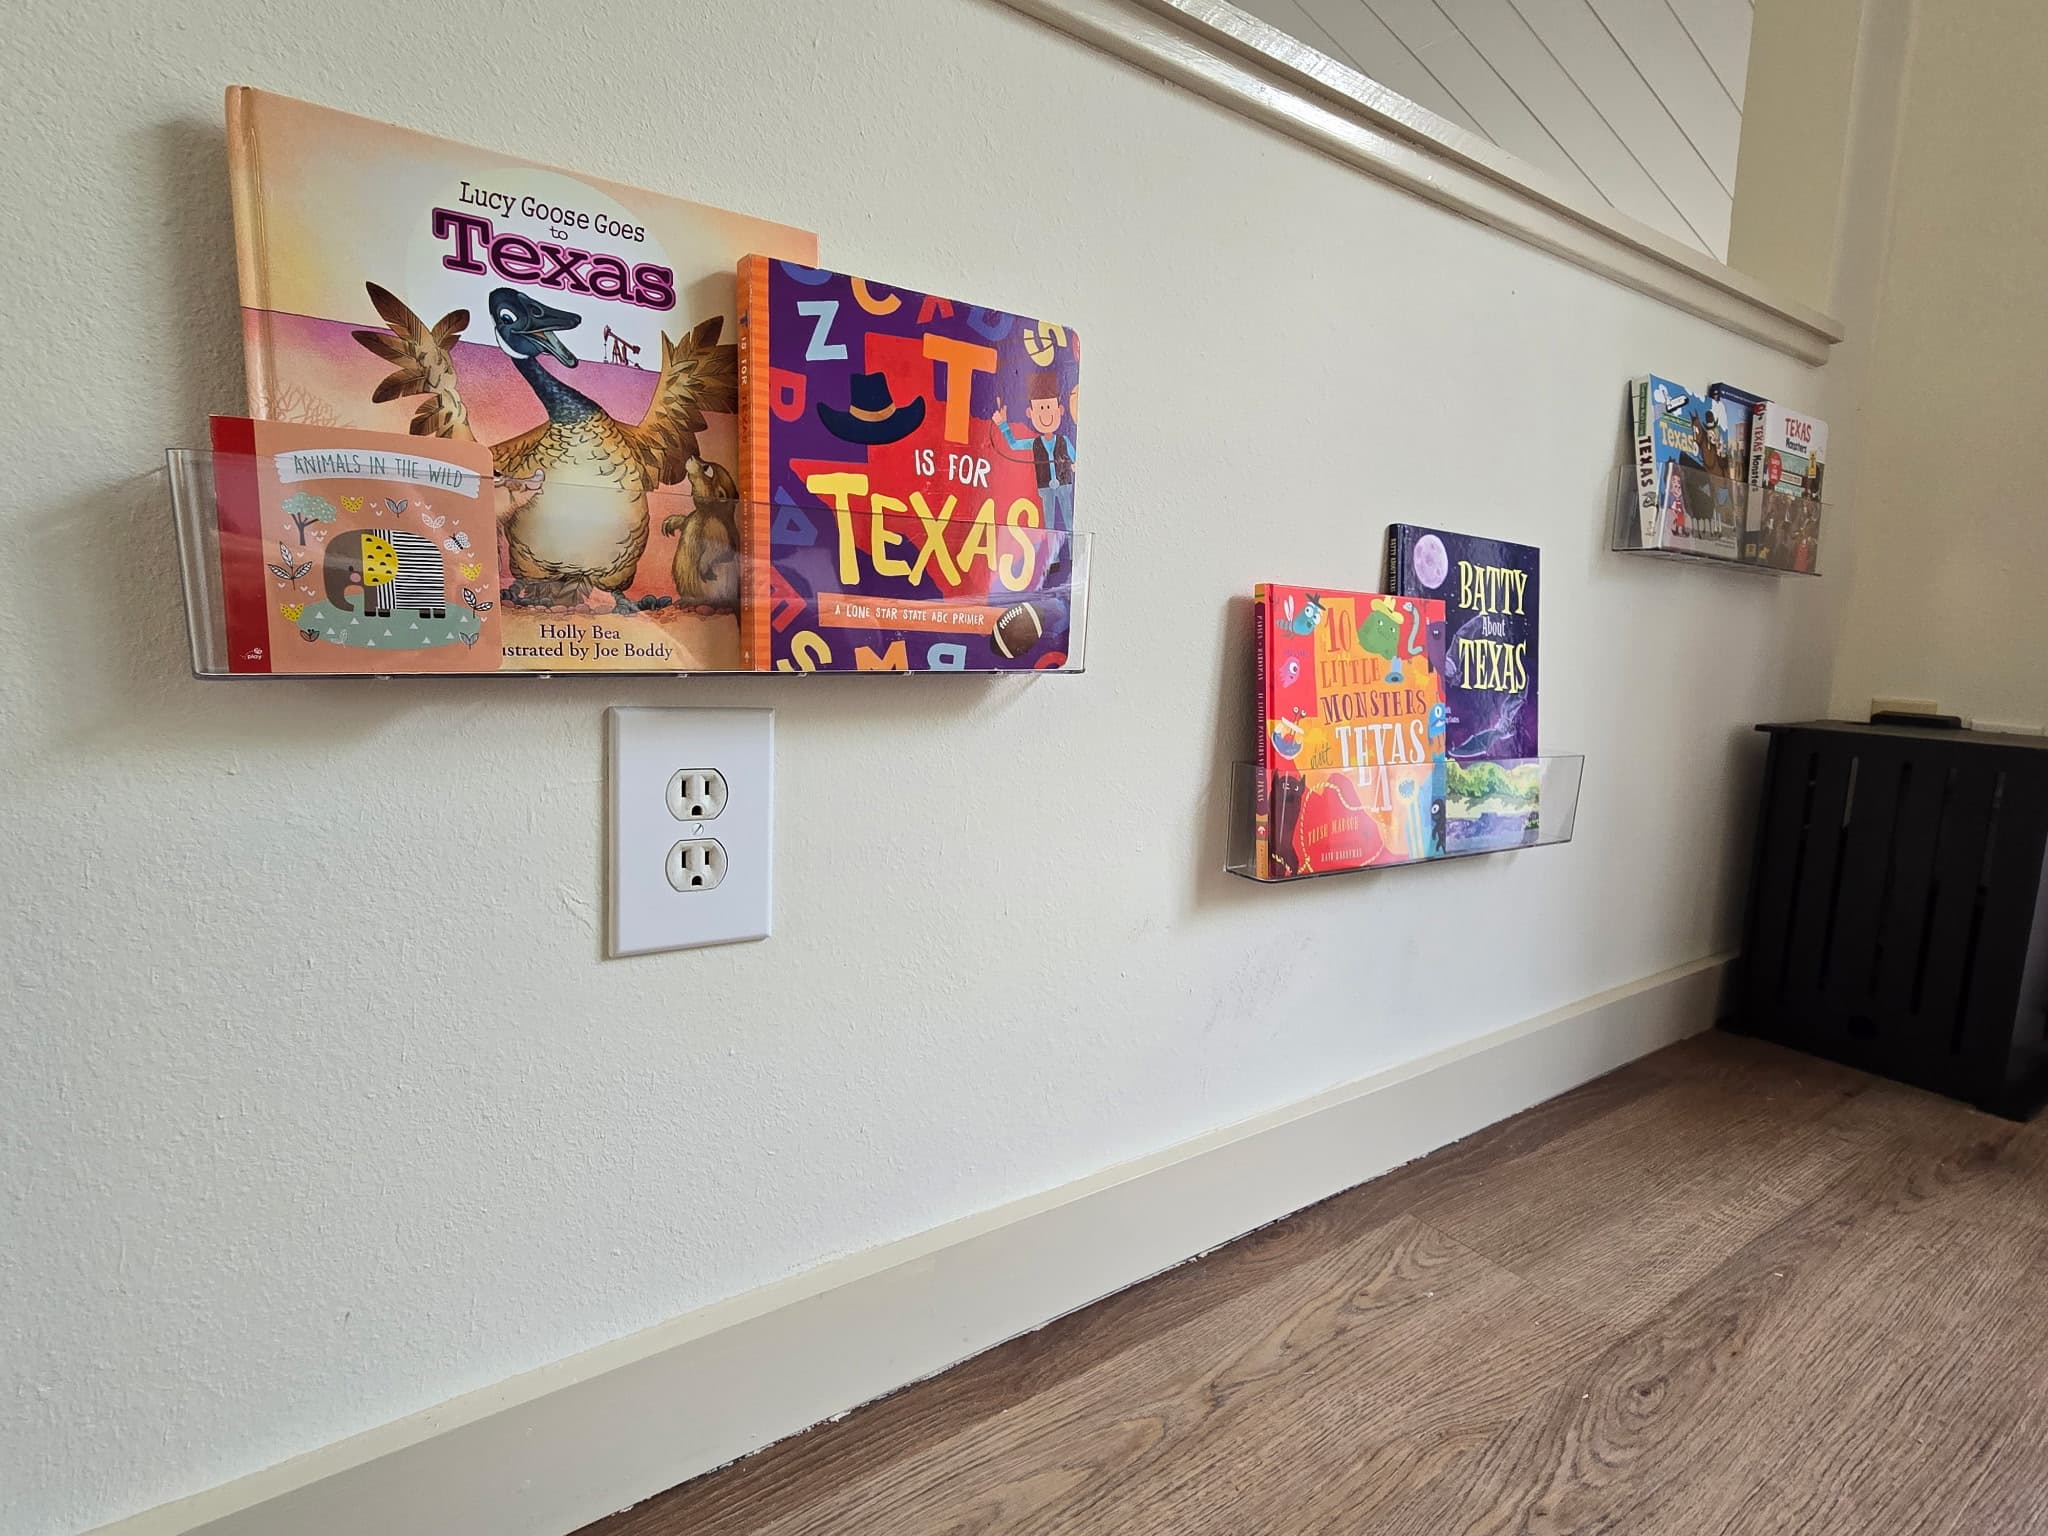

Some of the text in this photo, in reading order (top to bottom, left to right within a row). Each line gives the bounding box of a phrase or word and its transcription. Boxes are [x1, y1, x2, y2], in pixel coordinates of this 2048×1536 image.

[459, 181, 645, 242] Lucy Goose Goes
[549, 226, 568, 240] to
[432, 207, 676, 311] Texas
[922, 333, 998, 444] T
[1660, 421, 1700, 457] Texas
[1785, 418, 1812, 443] TEXAS
[294, 453, 463, 488] ANIMALS IN THE WILD
[914, 449, 991, 488] IS FOR
[1638, 435, 1654, 489] TEXAS
[806, 472, 1039, 592] TEXAS
[1458, 560, 1529, 616] BATTY
[834, 602, 985, 626] A LONE STAR STATE ABC PRIMER
[1324, 607, 1352, 653] 10
[1482, 616, 1506, 637] About
[539, 624, 620, 643] Holly Bea
[570, 642, 589, 660] by
[594, 643, 619, 660] Joe
[625, 643, 673, 660] Boddy
[1320, 656, 1381, 689] LITTLE
[1458, 638, 1528, 694] TEXAS
[1320, 689, 1427, 726] MONSTERS
[1335, 719, 1426, 812] TEXAS
